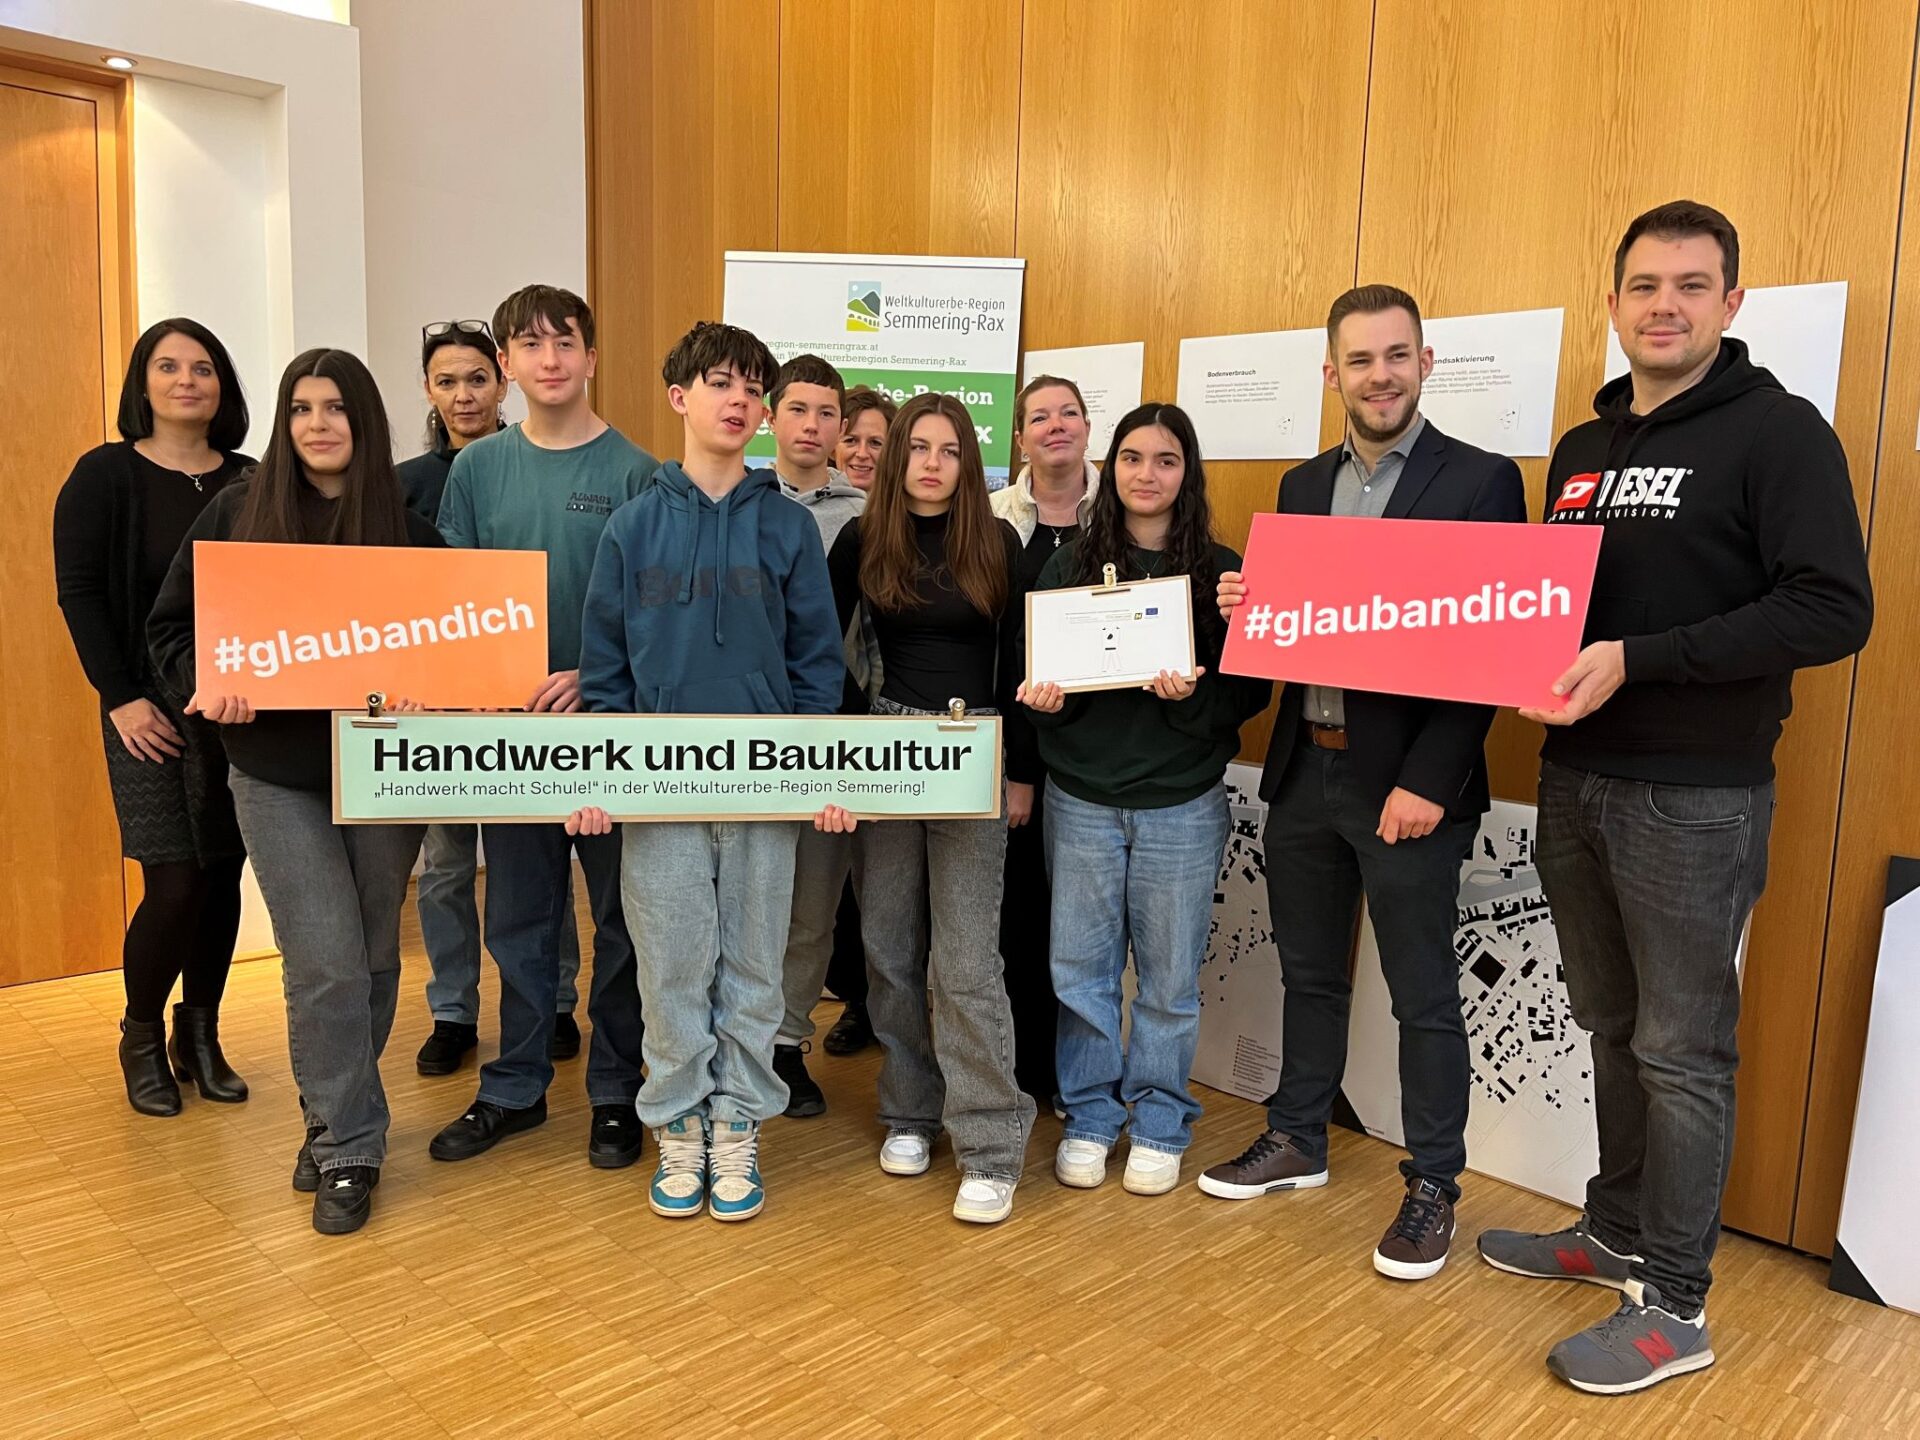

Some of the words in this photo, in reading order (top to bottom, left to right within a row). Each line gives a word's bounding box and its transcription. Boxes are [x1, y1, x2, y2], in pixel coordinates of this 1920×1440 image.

[885, 295, 1005, 312] Weltkulturerbe-Region
[884, 311, 1005, 335] Semmering-Rax
[766, 340, 879, 352] region-semmeringrax.at
[788, 351, 888, 365] Wlturerberegion
[890, 355, 967, 367] Semmering-Rax
[1433, 354, 1495, 365] andsaktivierung
[1206, 369, 1257, 378] Bodenverbrauch
[1596, 466, 1687, 508] DIESEL
[1243, 578, 1571, 648] #glaubandich
[214, 597, 536, 678] #glaubandich
[374, 738, 634, 772] Handwerk
[644, 739, 735, 772] und
[749, 739, 972, 771] Baukultur
[473, 781, 526, 795] macht
[603, 781, 617, 794] in
[622, 781, 649, 794] der
[653, 779, 832, 796] Weltkulturerbe-Region
[837, 779, 925, 796] Semmering!
